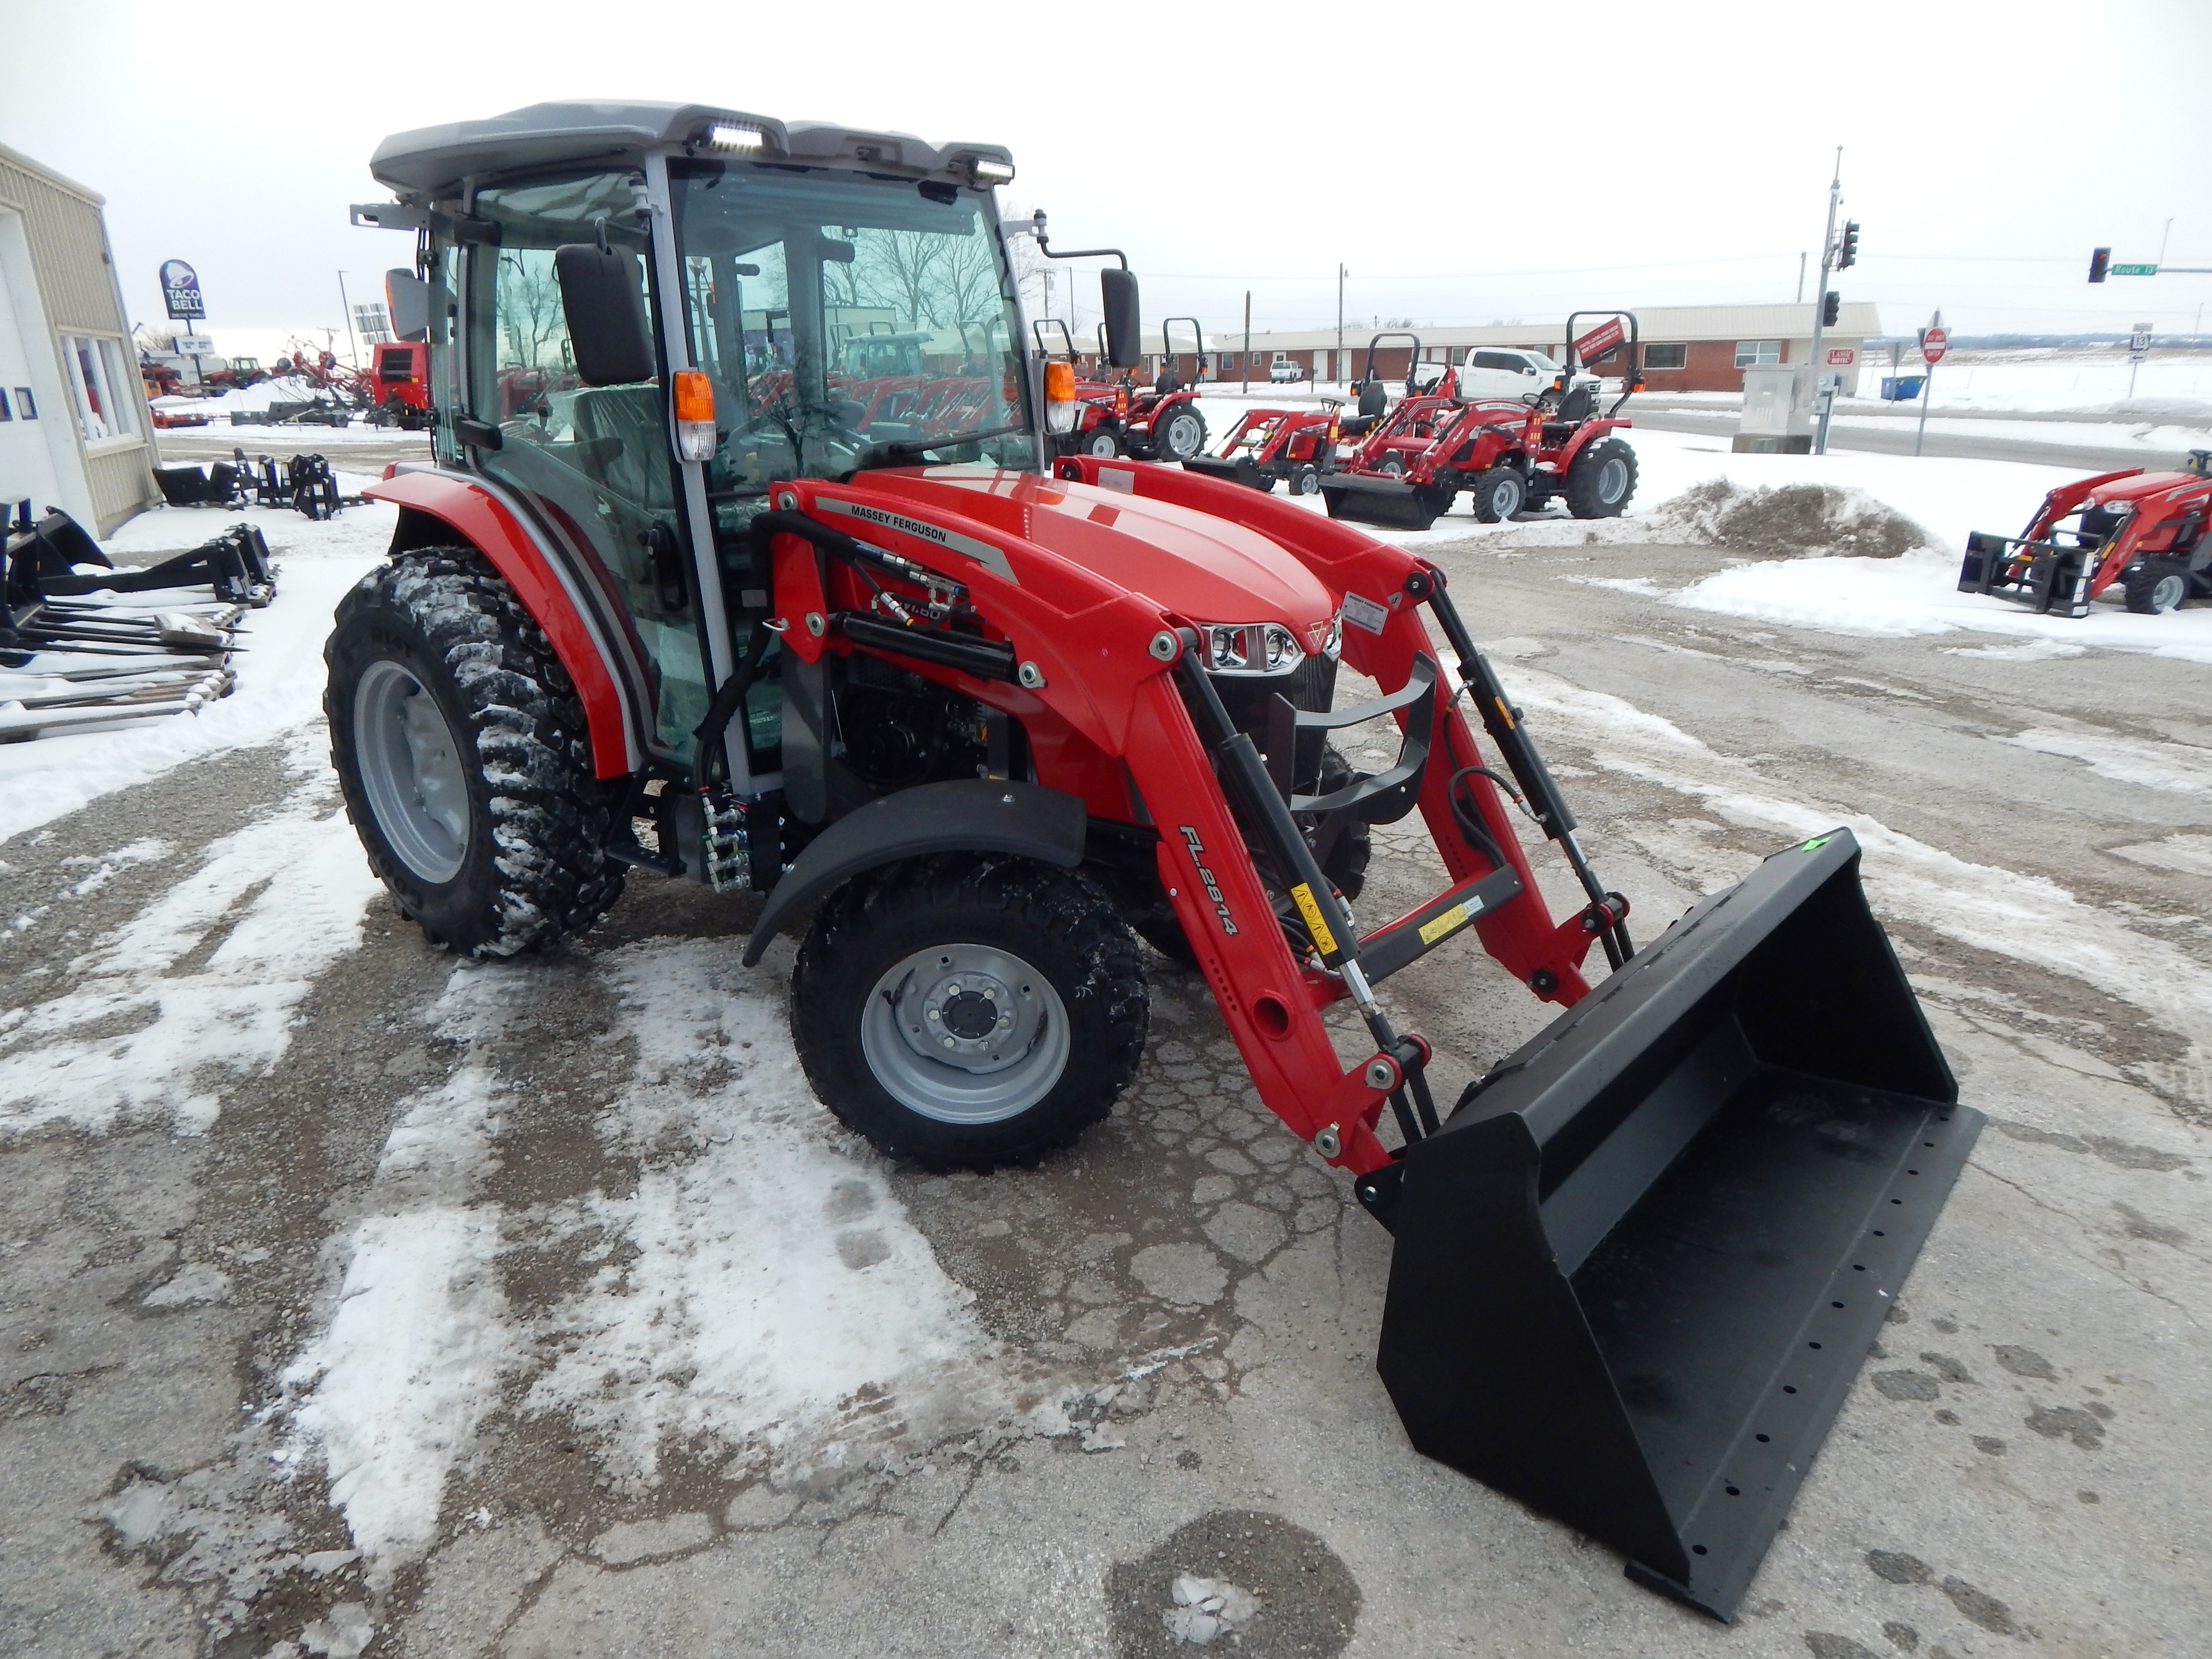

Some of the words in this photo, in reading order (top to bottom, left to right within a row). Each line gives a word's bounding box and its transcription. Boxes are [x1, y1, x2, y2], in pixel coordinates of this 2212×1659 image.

[2115, 265, 2140, 274] Route
[2144, 265, 2153, 274] 13
[166, 289, 200, 300] TACO
[171, 300, 203, 310] BELL
[2137, 337, 2146, 346] 13
[851, 505, 890, 523] MASSEY
[893, 517, 946, 542] FERGUSON
[1178, 825, 1240, 936] FL.2814
